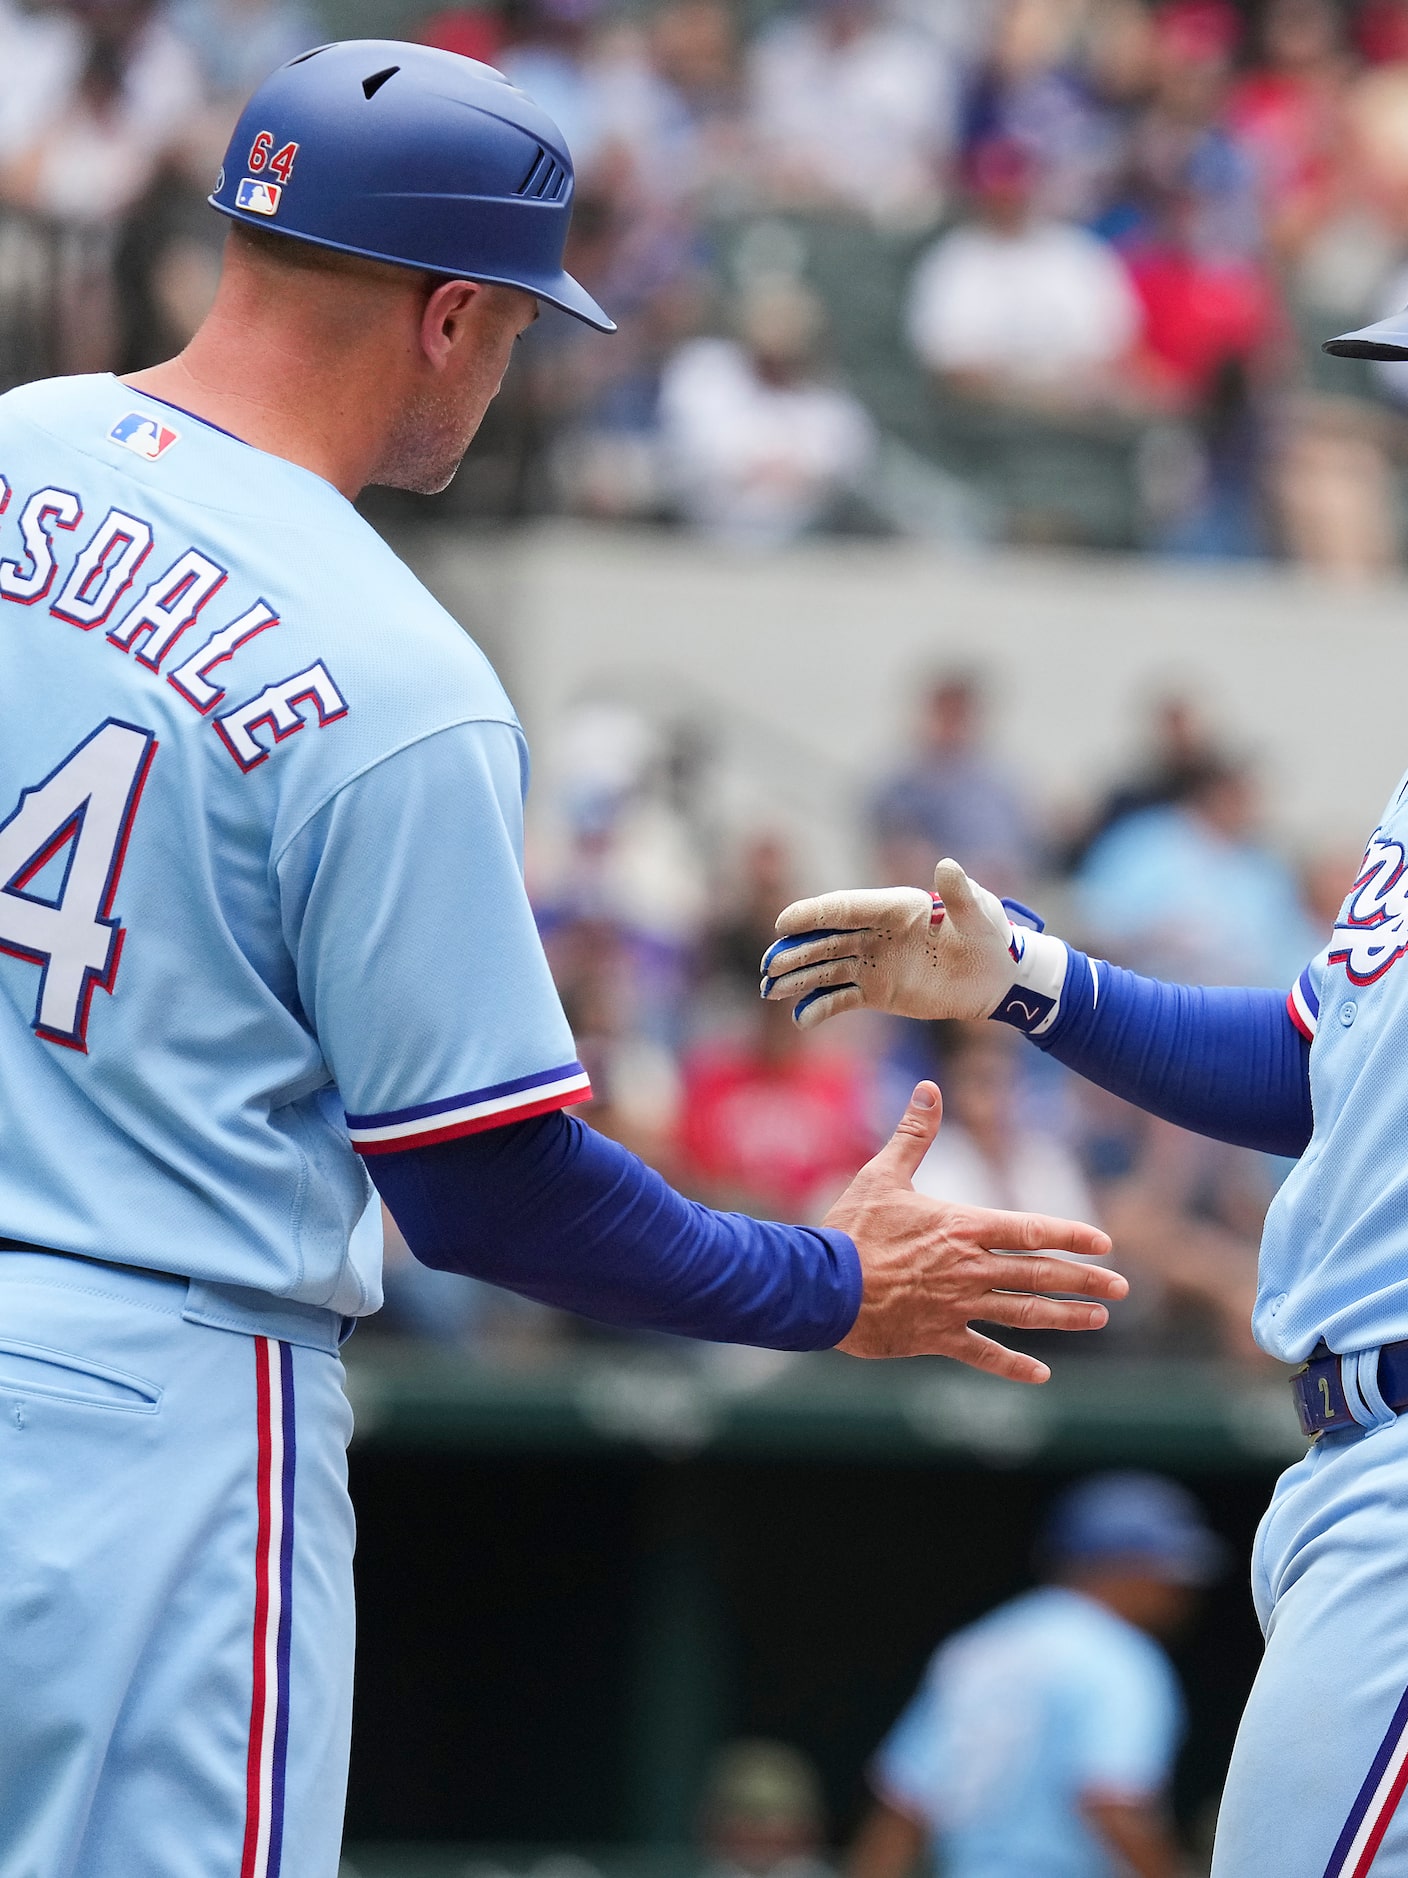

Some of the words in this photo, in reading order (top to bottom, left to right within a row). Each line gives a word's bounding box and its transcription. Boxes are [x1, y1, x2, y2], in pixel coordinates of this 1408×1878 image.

[247, 130, 300, 185] 64
[0, 474, 349, 774] SDALE
[1006, 1000, 1040, 1020] 2
[1318, 1377, 1335, 1418] 2
